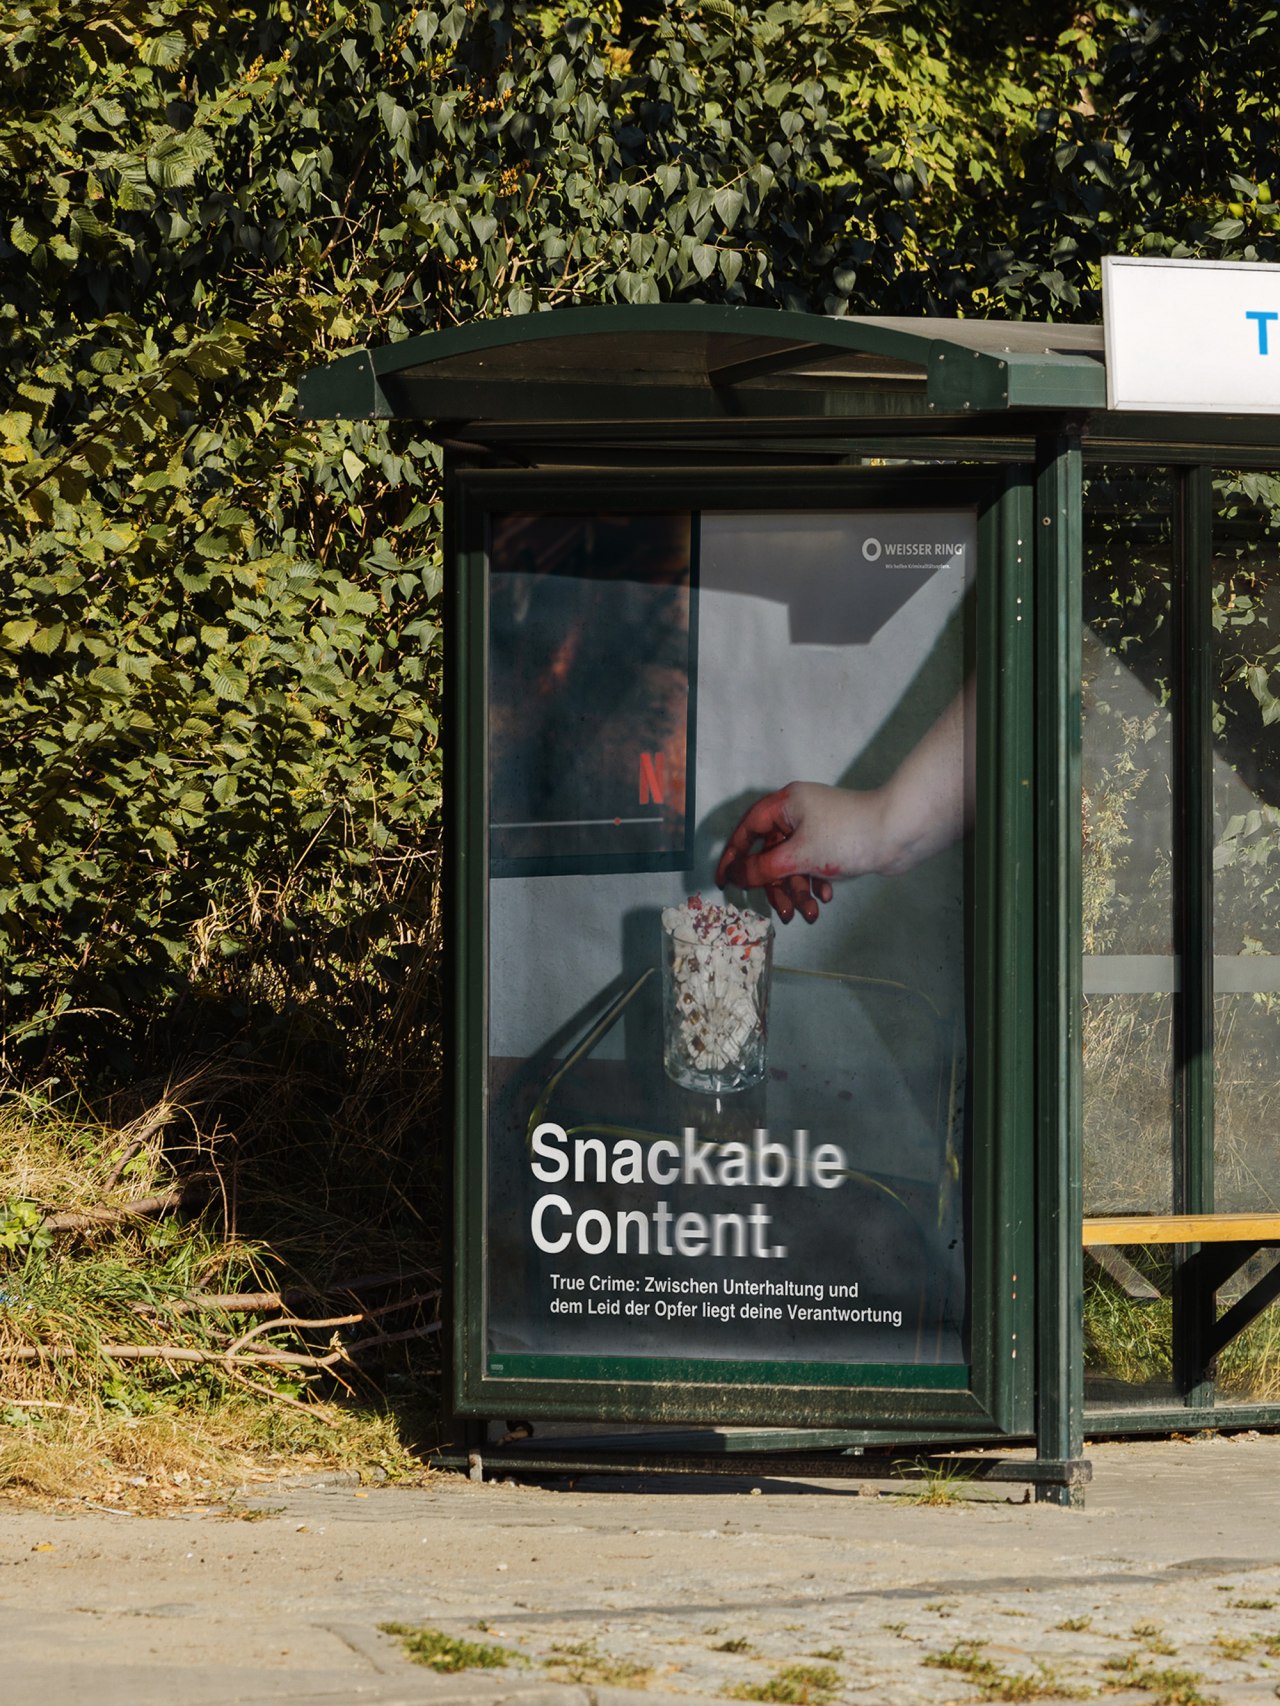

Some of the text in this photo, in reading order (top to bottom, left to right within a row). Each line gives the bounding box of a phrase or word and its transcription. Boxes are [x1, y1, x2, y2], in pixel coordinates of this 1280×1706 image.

[884, 543, 963, 555] WEISSER RING
[531, 1122, 847, 1189] Snackable
[531, 1193, 788, 1259] Content.
[551, 1274, 859, 1301] True Crime: Zwischen Unterhaltung und
[550, 1298, 902, 1327] dem Leid der Opfer liegt deine Verantwortung
